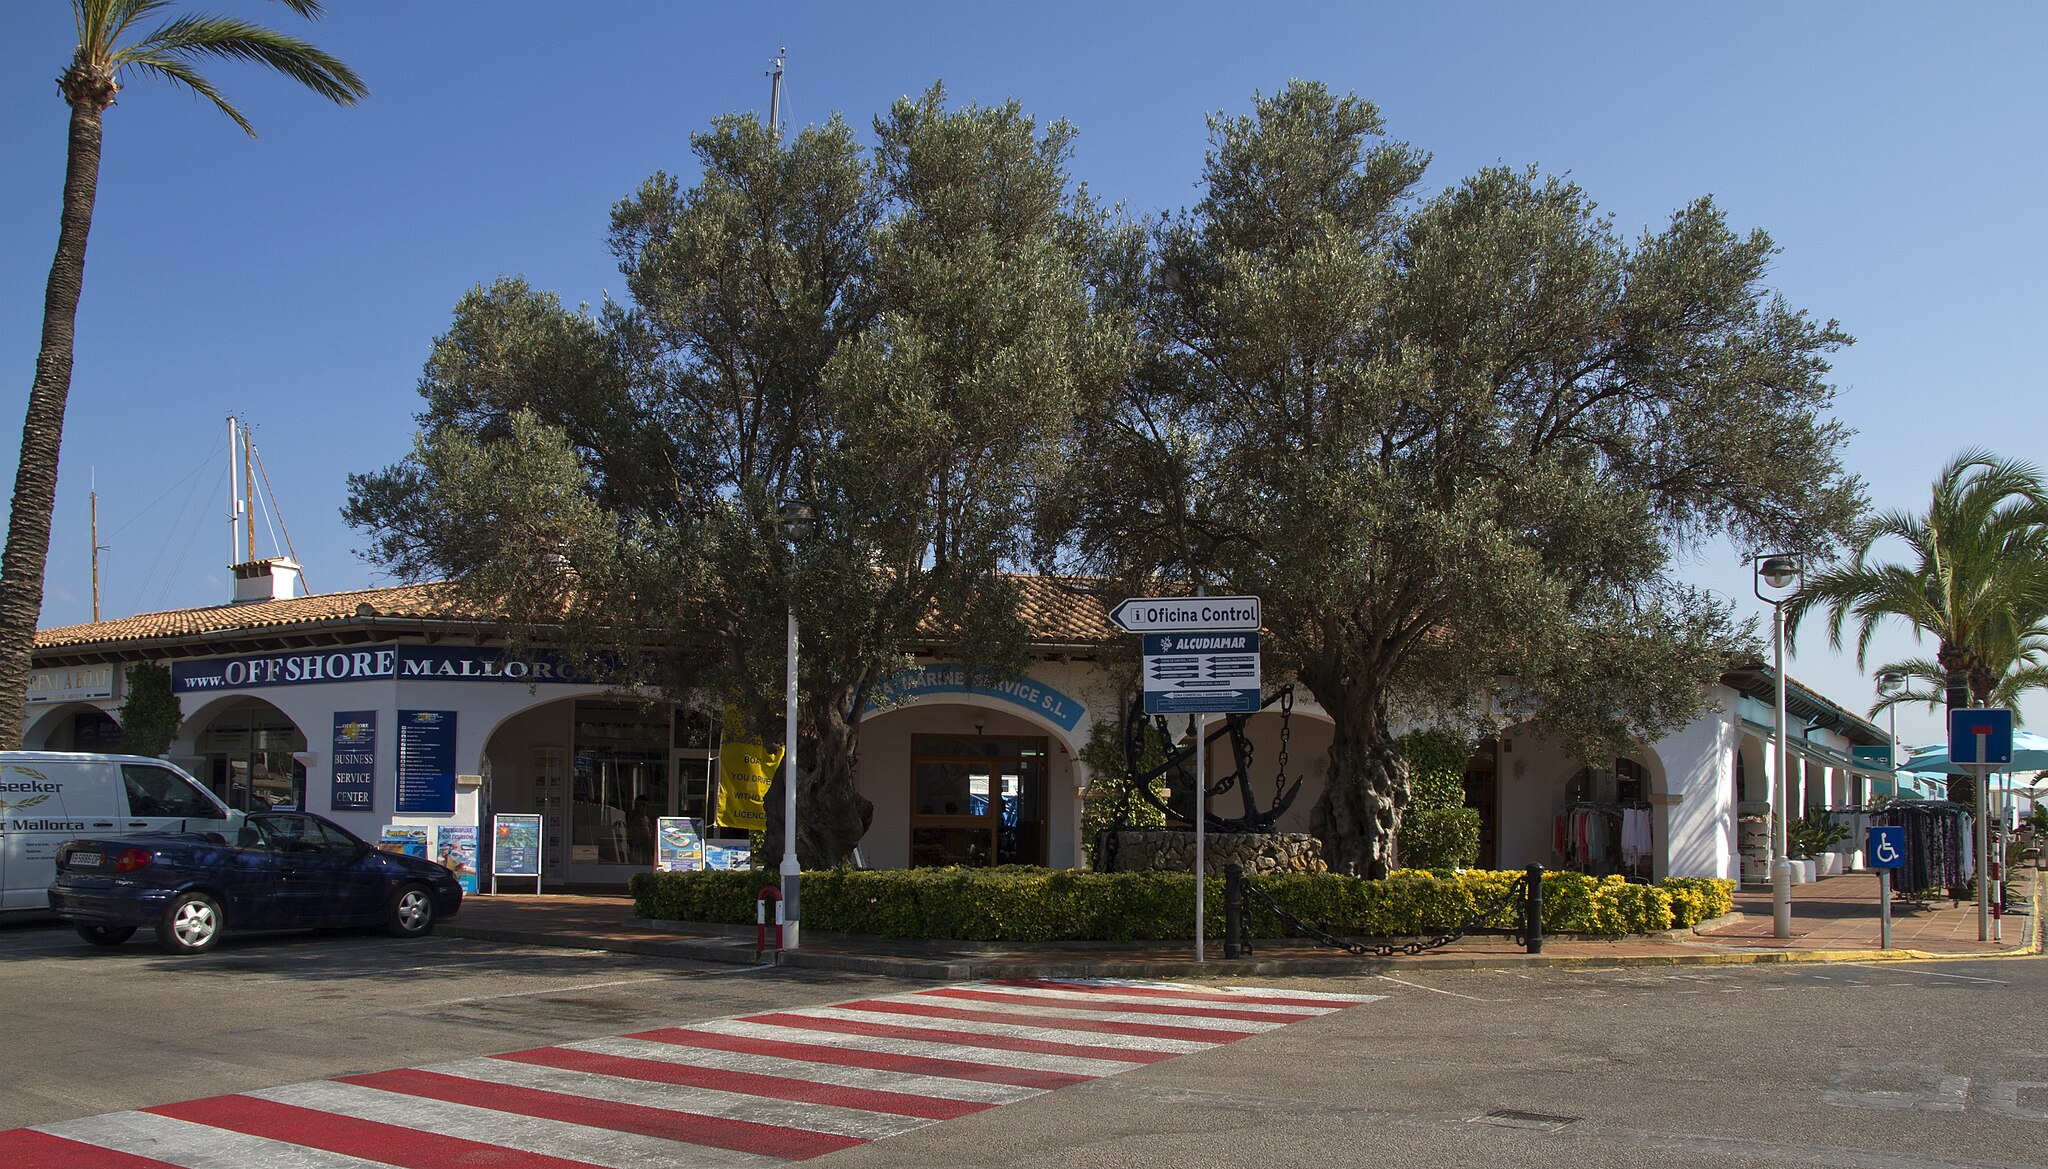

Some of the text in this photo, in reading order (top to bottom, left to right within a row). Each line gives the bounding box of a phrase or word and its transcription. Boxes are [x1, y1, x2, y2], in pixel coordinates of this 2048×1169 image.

[1147, 607, 1198, 623] Oficina
[1202, 606, 1256, 622] Control
[1176, 637, 1246, 650] ALCUDIAMAR
[401, 658, 596, 680] MALLORC
[64, 671, 72, 690] A
[75, 668, 109, 689] BOAT
[1042, 694, 1067, 719] S.L.
[335, 754, 374, 765] BUSINESS
[744, 755, 763, 765] BOA
[335, 773, 371, 783] SERVICE
[731, 772, 772, 786] YOU DRIVE
[336, 791, 369, 802] CENTER
[734, 791, 764, 802] WITHO
[13, 819, 84, 831] Mallorca
